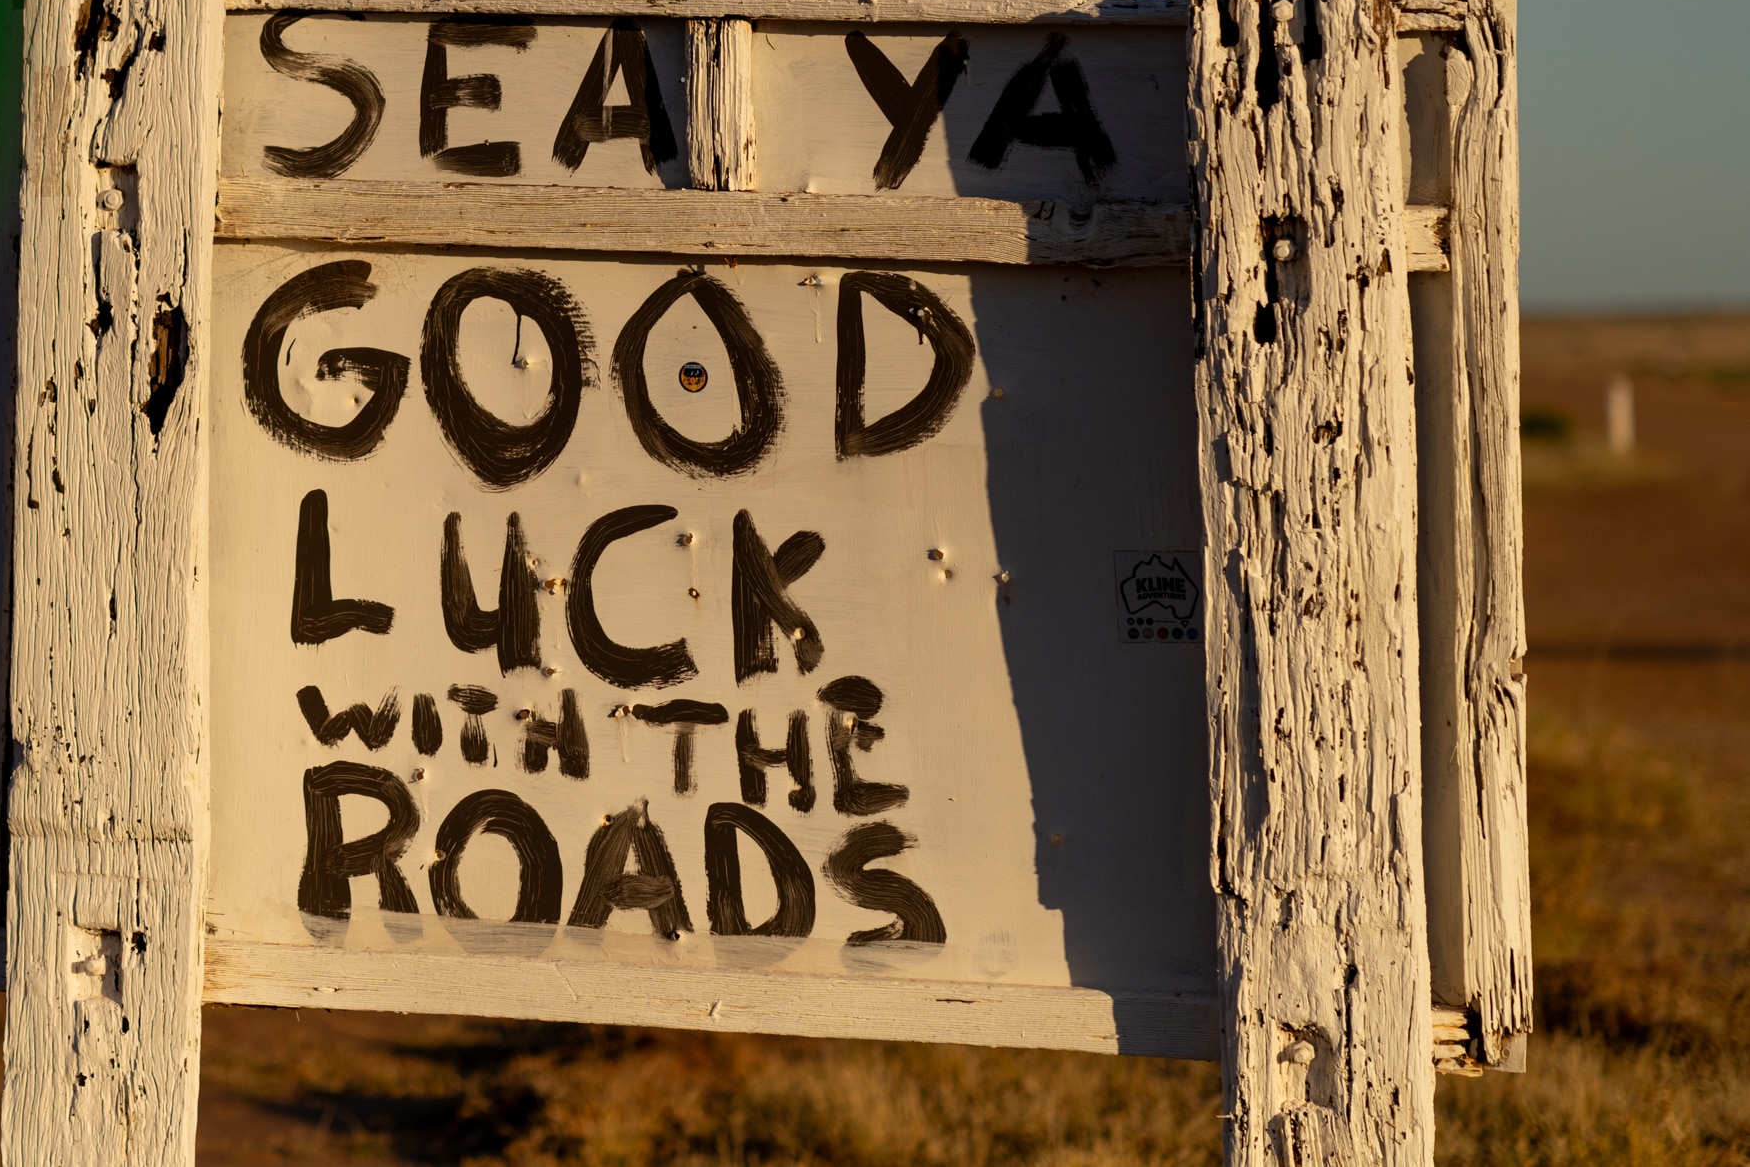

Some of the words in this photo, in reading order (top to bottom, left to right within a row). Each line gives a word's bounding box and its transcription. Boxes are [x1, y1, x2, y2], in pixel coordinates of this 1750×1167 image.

[260, 9, 678, 180] SEA
[844, 29, 1117, 191] YA
[242, 259, 977, 493] GOOD
[290, 488, 827, 690] LUCK
[1135, 576, 1187, 594] KLINE
[1136, 591, 1187, 601] ADVENTURES
[296, 683, 591, 781] WITH
[631, 675, 911, 817] THE
[296, 759, 948, 954] ROADS
